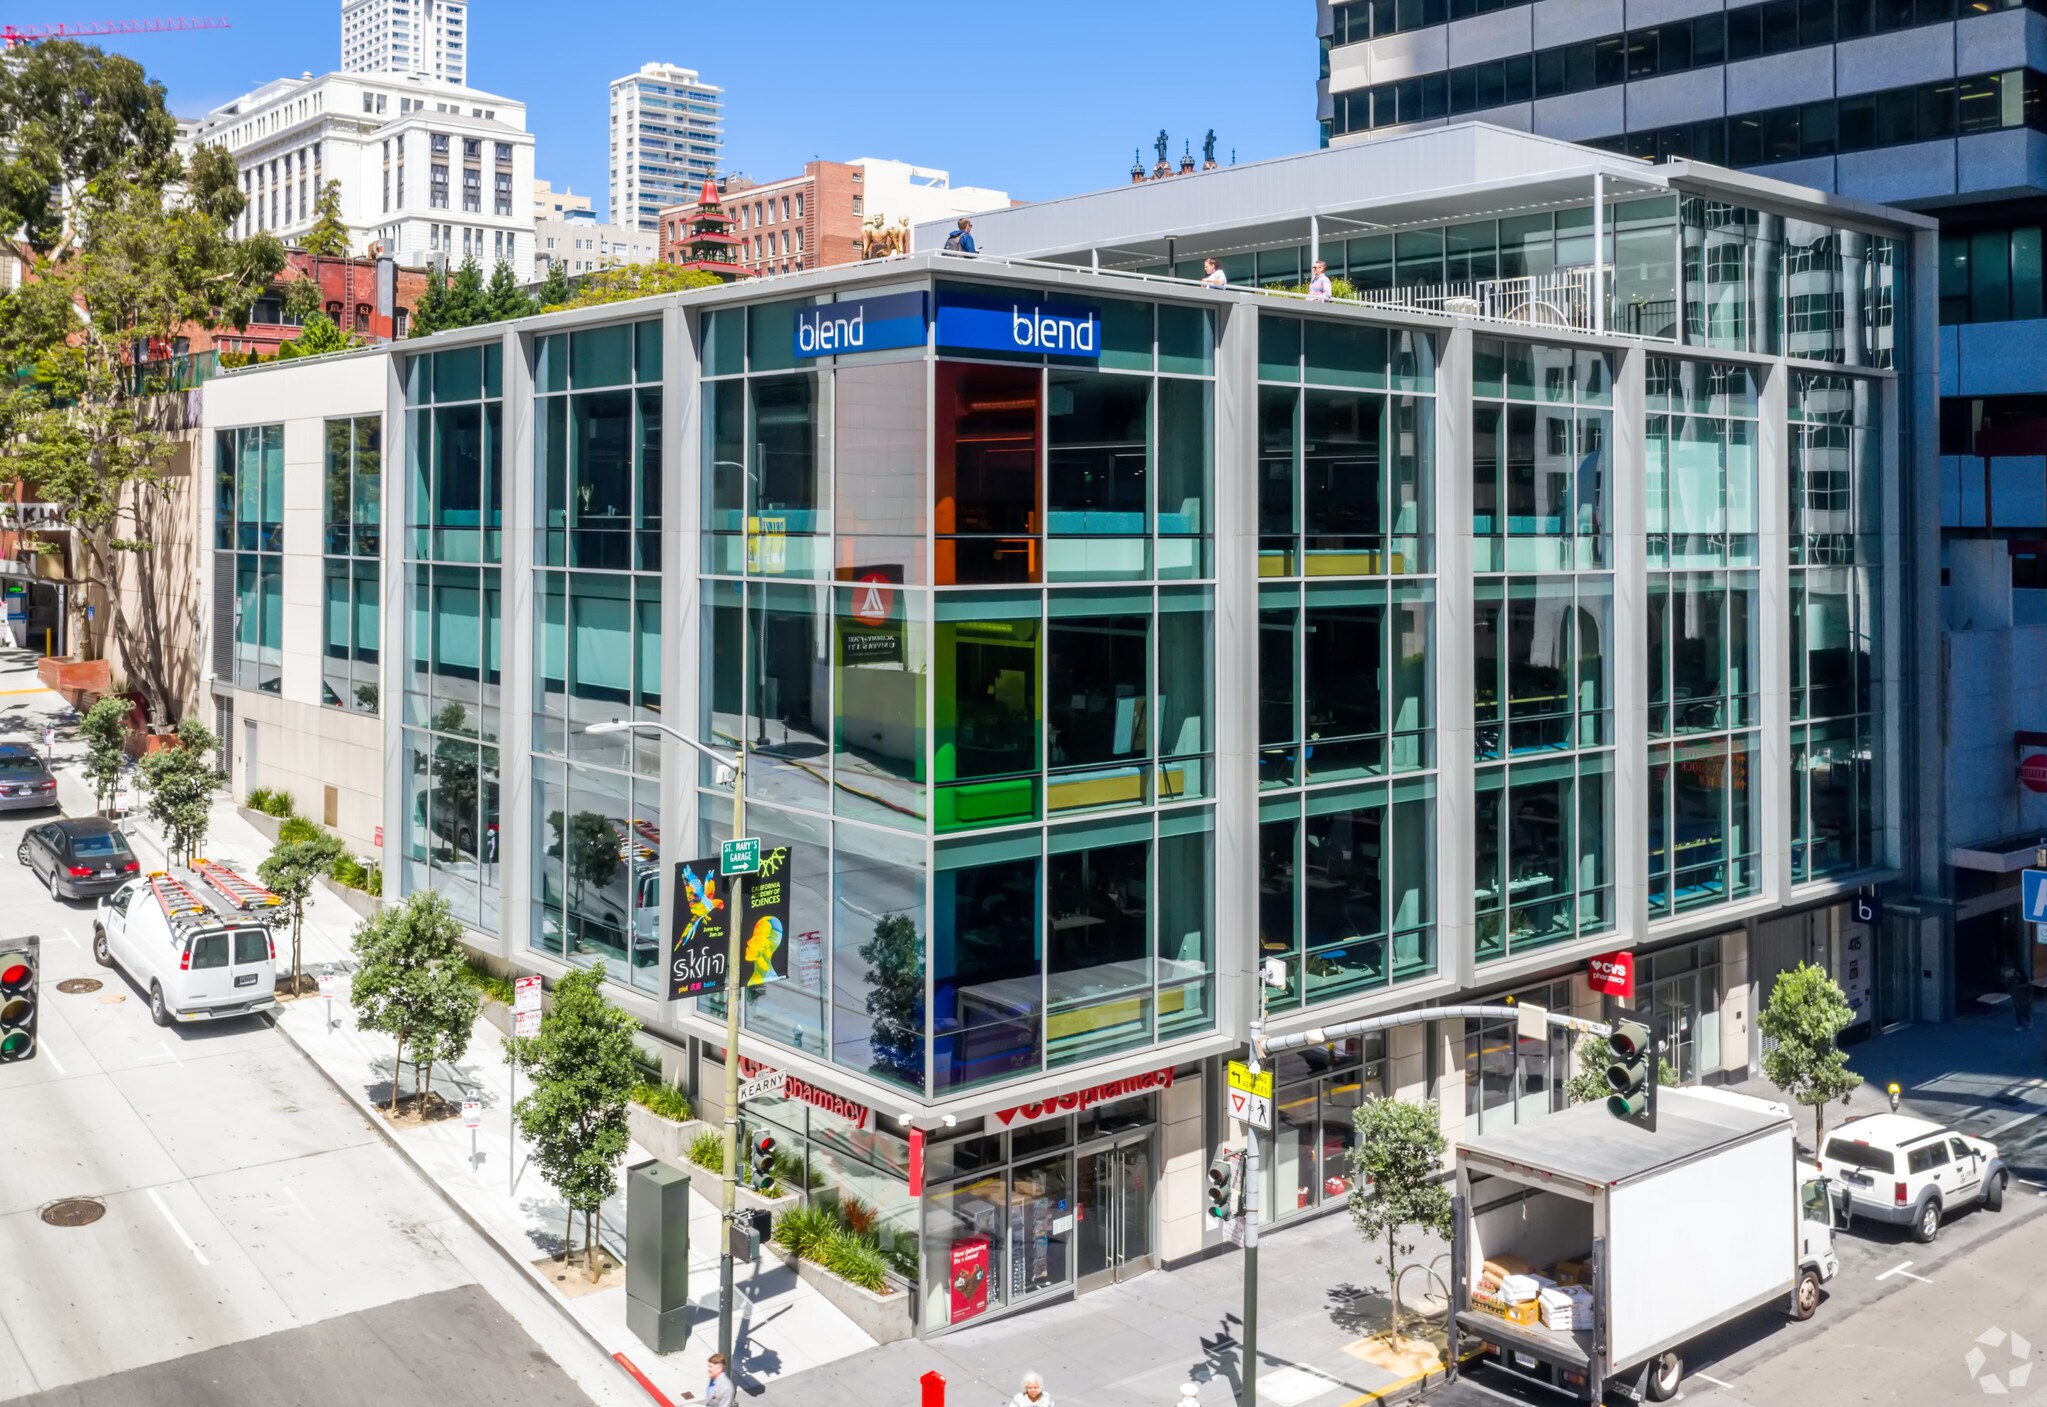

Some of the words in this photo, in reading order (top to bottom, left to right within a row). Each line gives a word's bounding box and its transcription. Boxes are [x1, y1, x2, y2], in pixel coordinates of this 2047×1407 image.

[800, 305, 863, 351] blend
[1013, 304, 1093, 350] blend
[724, 843, 734, 853] ST.
[736, 841, 758, 851] MARY'S
[730, 852, 752, 862] GARAGE
[751, 882, 781, 893] CALIFORNIA
[751, 889, 774, 900] ACADEMY
[751, 895, 781, 908] SCIENCES
[1859, 899, 1872, 920] b
[1848, 936, 1862, 951] 415
[673, 946, 725, 981] skin
[1602, 962, 1627, 976] CVS
[1593, 972, 1626, 985] pharmacy
[741, 1074, 784, 1099] KEARNY
[783, 1075, 869, 1130] pharmacy
[965, 1244, 987, 1256] delivering
